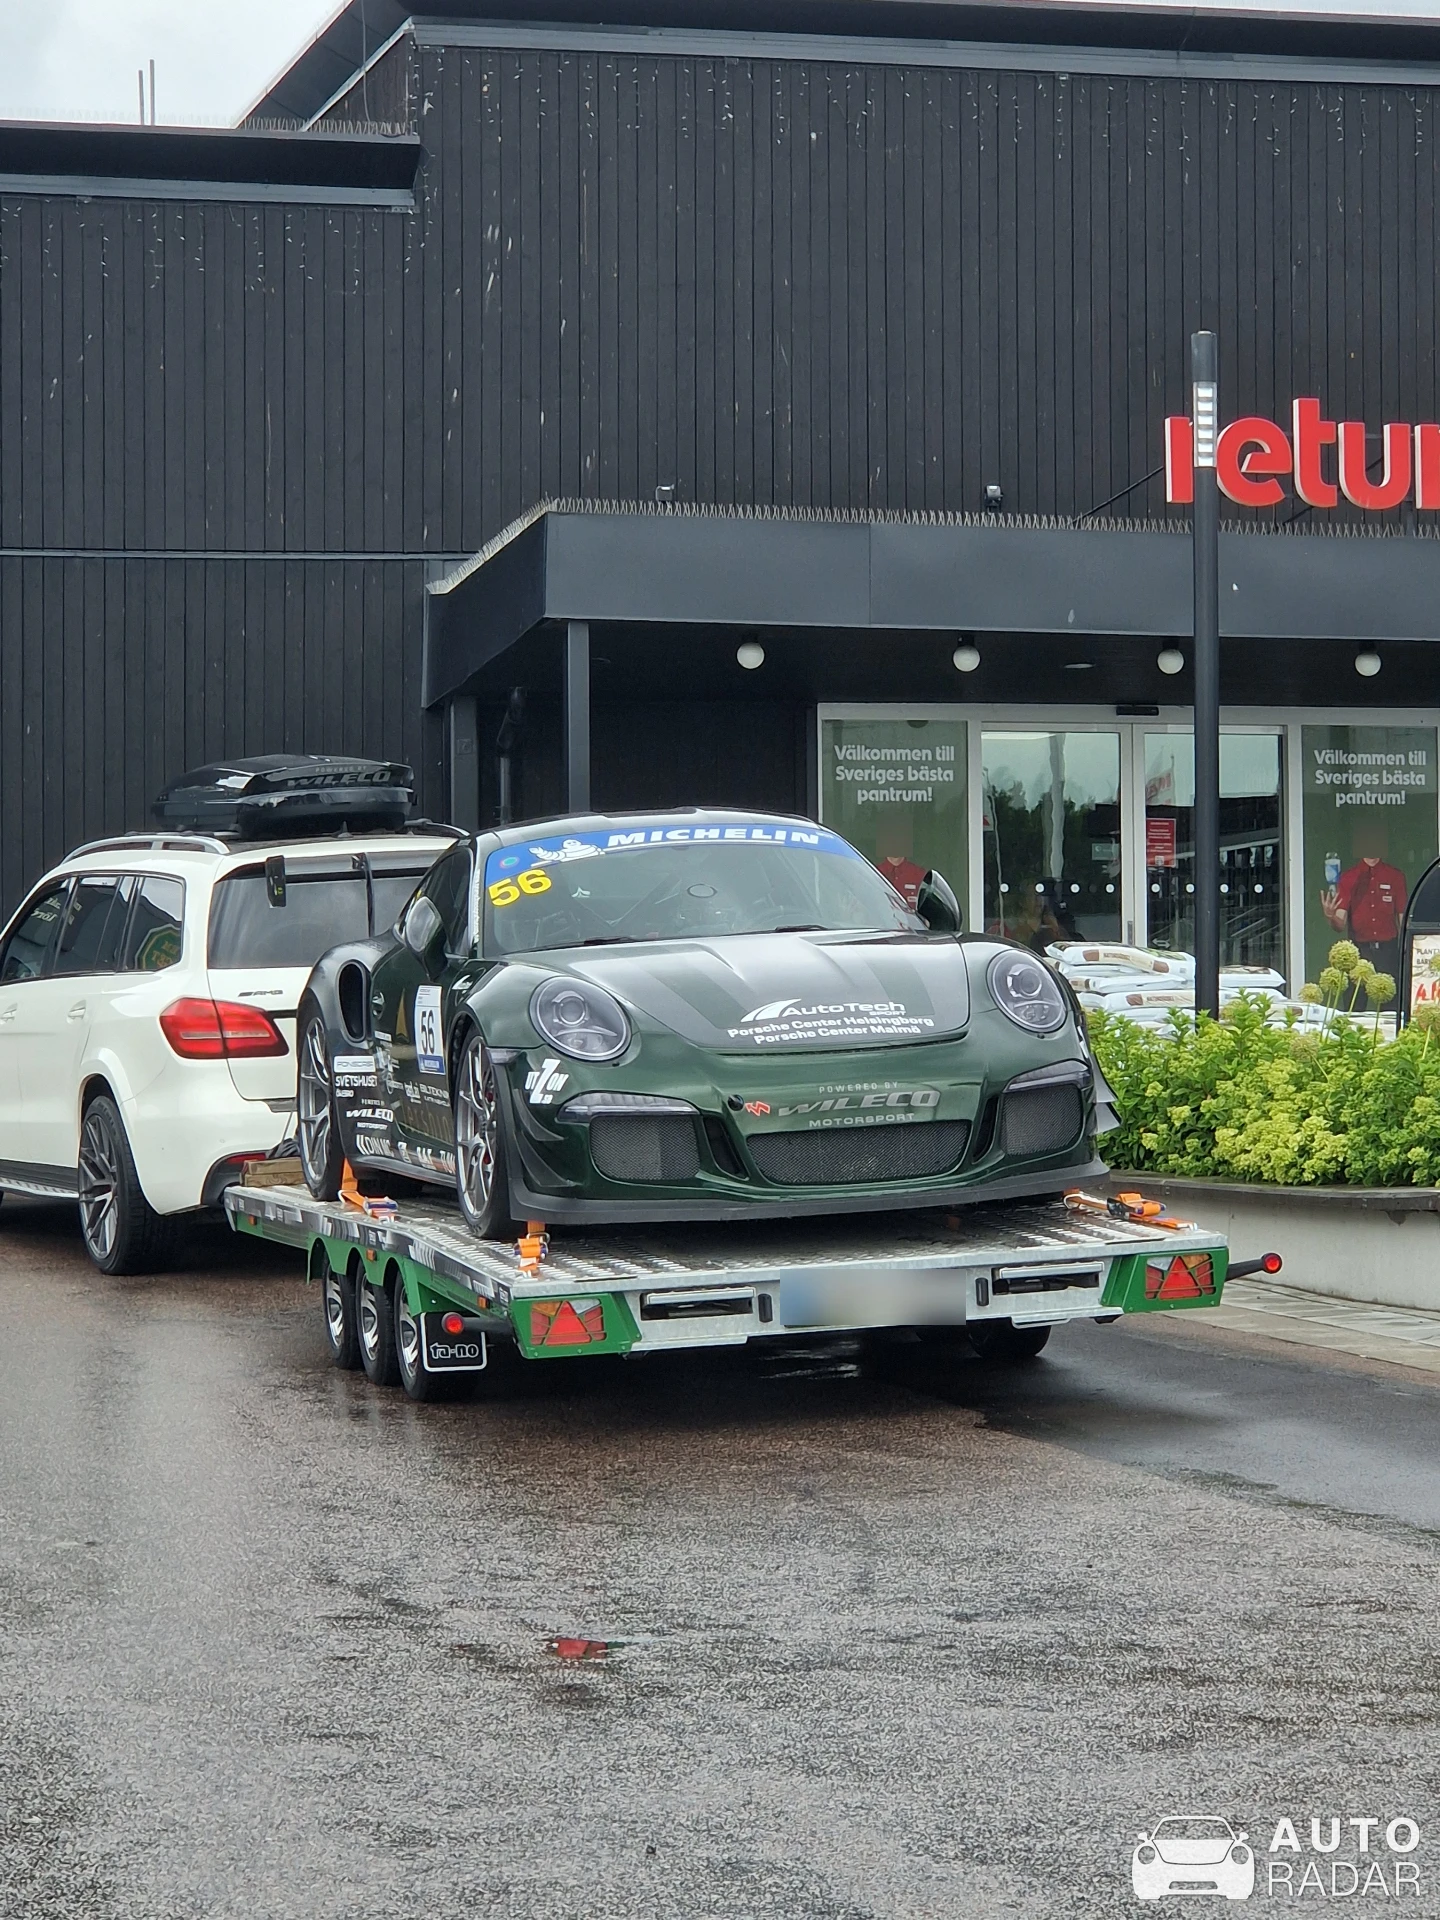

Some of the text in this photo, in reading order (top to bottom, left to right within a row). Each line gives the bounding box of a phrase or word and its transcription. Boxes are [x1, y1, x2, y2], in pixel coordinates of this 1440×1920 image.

[834, 745, 955, 761] Välkommen till
[1314, 749, 1426, 766] Välkommen till
[287, 769, 391, 787] WILECO
[835, 765, 954, 784] Sveriges bästa
[1315, 769, 1426, 788] Sveriges bästa
[857, 787, 933, 805] pantrum!
[1335, 790, 1406, 807] pantrum!
[607, 828, 819, 847] MICHELIN
[488, 869, 552, 907] 56
[782, 1001, 905, 1018] AutoTech
[420, 1009, 435, 1055] 56
[727, 1016, 935, 1038] Porsche Center Helsingborg
[754, 1024, 921, 1045] Porsche Center Malmö
[335, 1074, 378, 1087] SVETSHUSET
[819, 1082, 899, 1094] POWERED BY
[778, 1090, 942, 1117] WILECO
[346, 1108, 394, 1122] WILECO
[809, 1112, 915, 1128] MOTORSPORT
[430, 1342, 479, 1359] ta-no
